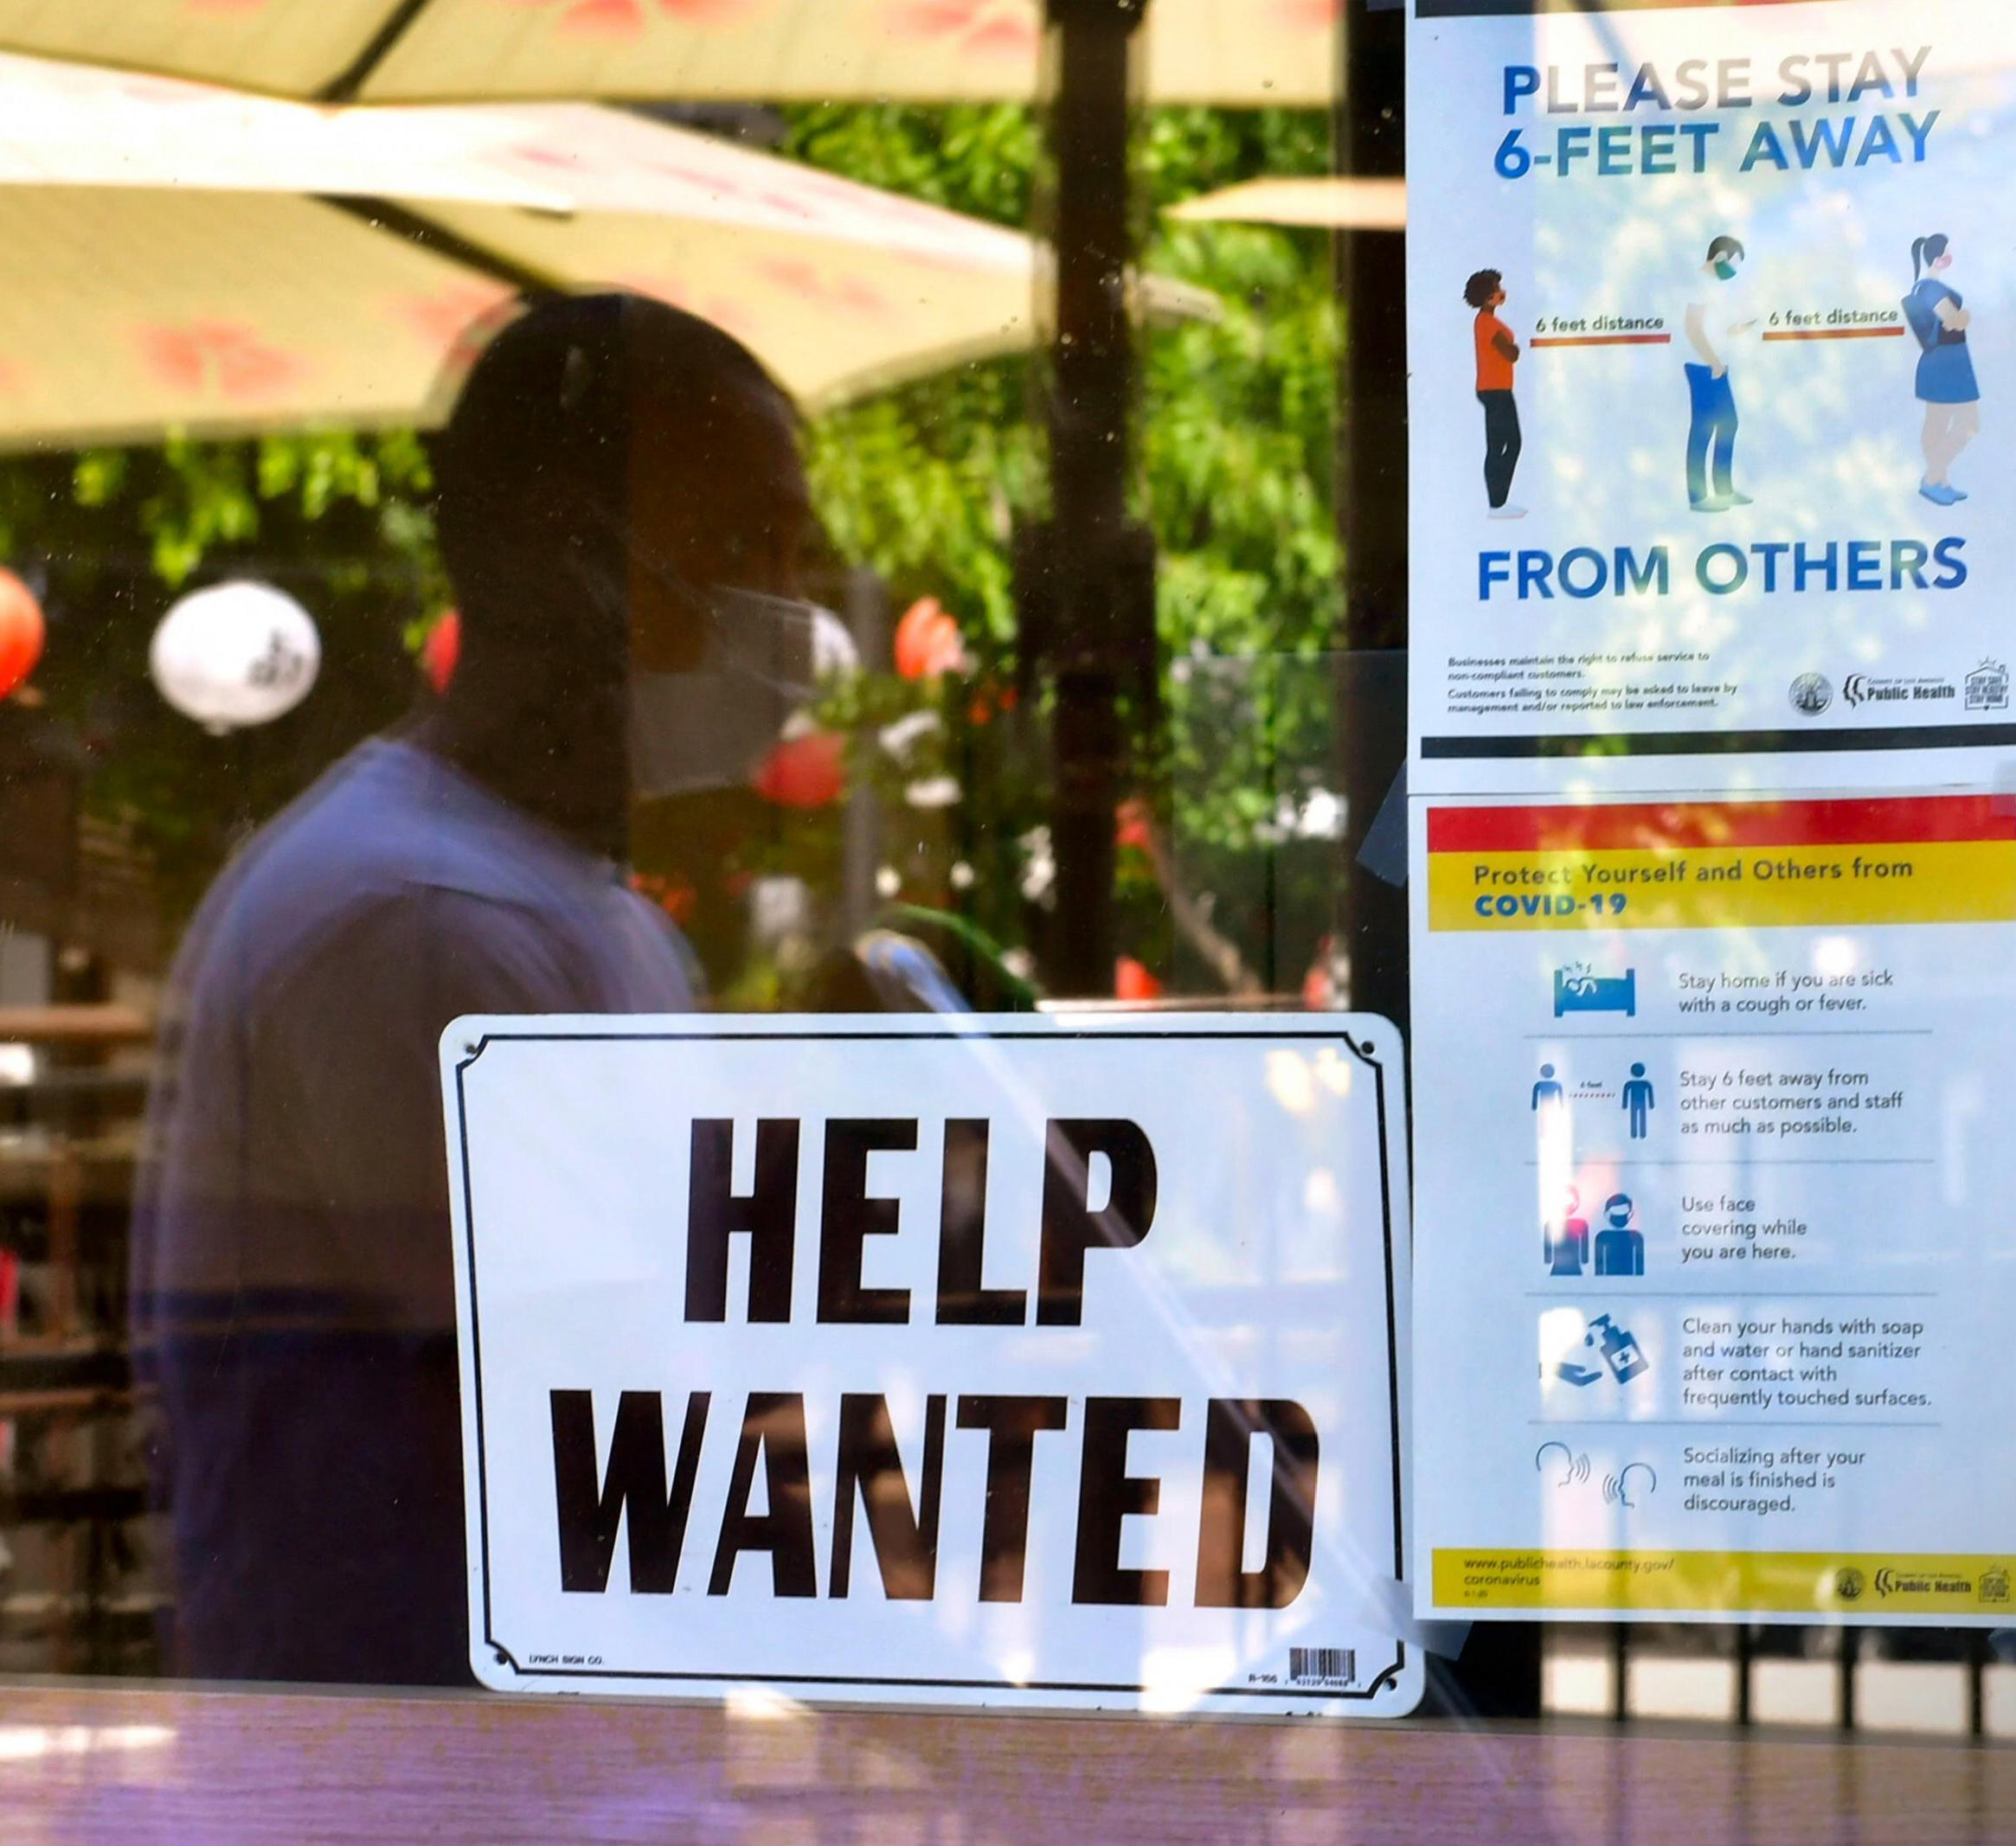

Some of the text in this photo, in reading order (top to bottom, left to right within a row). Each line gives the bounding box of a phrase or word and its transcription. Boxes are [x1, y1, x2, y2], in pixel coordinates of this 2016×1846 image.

[1502, 46, 1932, 114] PLEASE STAY
[1493, 111, 1940, 179] 6-FEET AWAY
[1536, 315, 1664, 332] 6 feet distance
[1769, 308, 1897, 325] 6 feet distance
[1479, 537, 1968, 599] FROM OTHERS
[1448, 657, 1506, 666] Businesses
[1510, 657, 1554, 665] maintain
[1557, 654, 1575, 663] the
[1578, 654, 1602, 666] right
[1658, 651, 1694, 661] service
[1448, 670, 1585, 682] non-compliant customers.
[1448, 689, 1506, 699] Customers
[1560, 687, 1598, 698] comply
[1626, 685, 1639, 694] be
[1677, 684, 1688, 693] to
[1724, 683, 1737, 695] by
[1867, 687, 1909, 701] Public
[1913, 685, 1955, 699] Health
[1448, 703, 1518, 715] management
[1522, 702, 1557, 712] and/or
[1473, 858, 1913, 884] Protect Yourself and Others from
[1474, 894, 1628, 917] COVID-19
[1679, 971, 1894, 993] Stay home if you are sick
[1679, 995, 1866, 1016] with a cough or fever.
[1680, 1070, 1869, 1092] Stay 6 feet away from
[1680, 1092, 1904, 1111] other customers and staff
[1680, 1116, 1857, 1138] as much as possible.
[1682, 1195, 1756, 1213] Use face
[684, 1117, 1158, 1326] HELP
[1681, 1219, 1807, 1240] covering while
[1681, 1243, 1796, 1263] you are here.
[1683, 1318, 1923, 1339] Clean your hands with soap
[1683, 1342, 1922, 1359] and water or hand sanitizer
[1683, 1364, 1837, 1381] after contact with
[1683, 1388, 1931, 1410] frequently touched surfaces.
[1683, 1447, 1865, 1469] Socializing after your
[1684, 1471, 1835, 1489] meal is finished is
[549, 1388, 1320, 1609] WANTED
[1684, 1495, 1795, 1516] discouraged.
[1464, 1556, 1675, 1573] www.publichealth.lacounty.gov/
[1464, 1575, 1540, 1585] coronavirus
[1895, 1581, 1929, 1592] Public
[1935, 1581, 1971, 1593] Health
